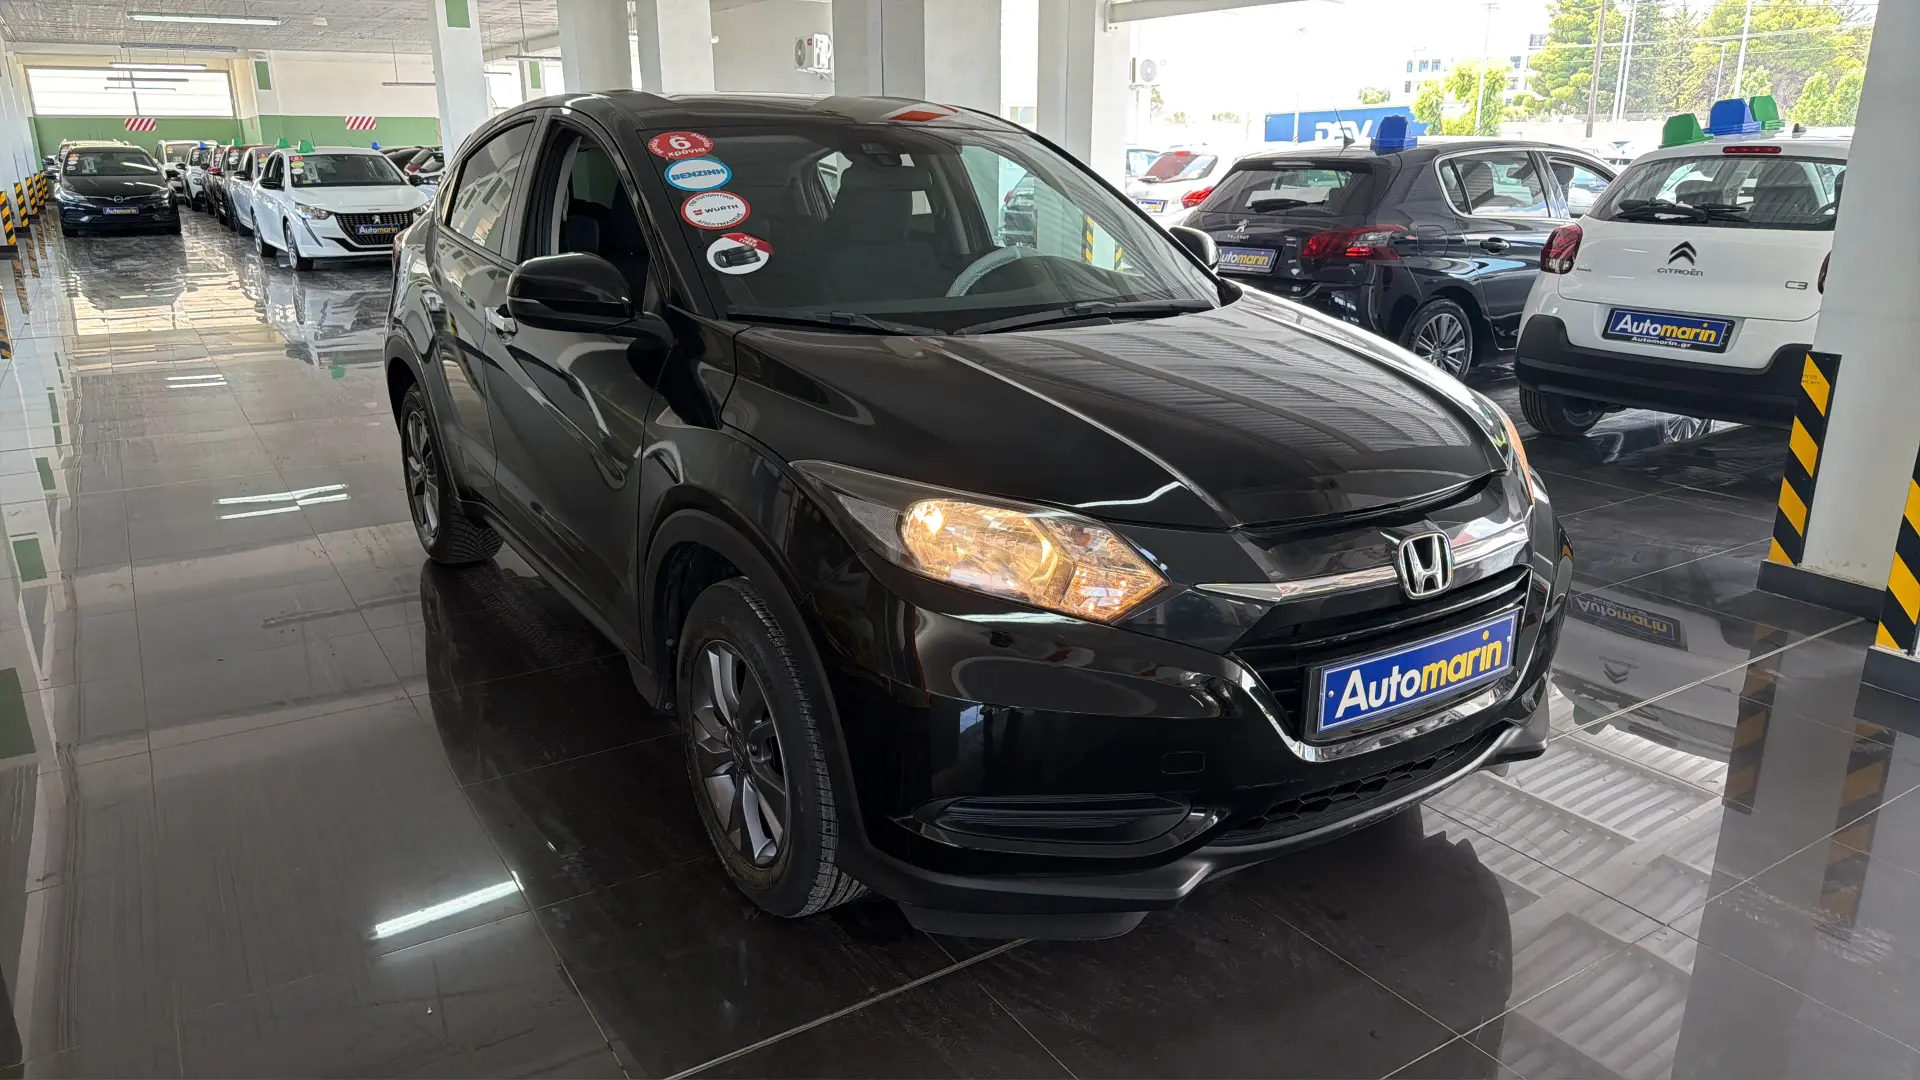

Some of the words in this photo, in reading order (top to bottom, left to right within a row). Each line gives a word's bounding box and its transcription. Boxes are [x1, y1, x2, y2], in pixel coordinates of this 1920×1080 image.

[669, 137, 692, 150] 6
[106, 207, 137, 215] Automarin
[360, 225, 398, 234] Automarin
[1784, 280, 1809, 290] C3
[1615, 314, 1717, 343] Automarin
[1631, 336, 1692, 348] Automarin.gr
[1335, 630, 1502, 719] Automarin
